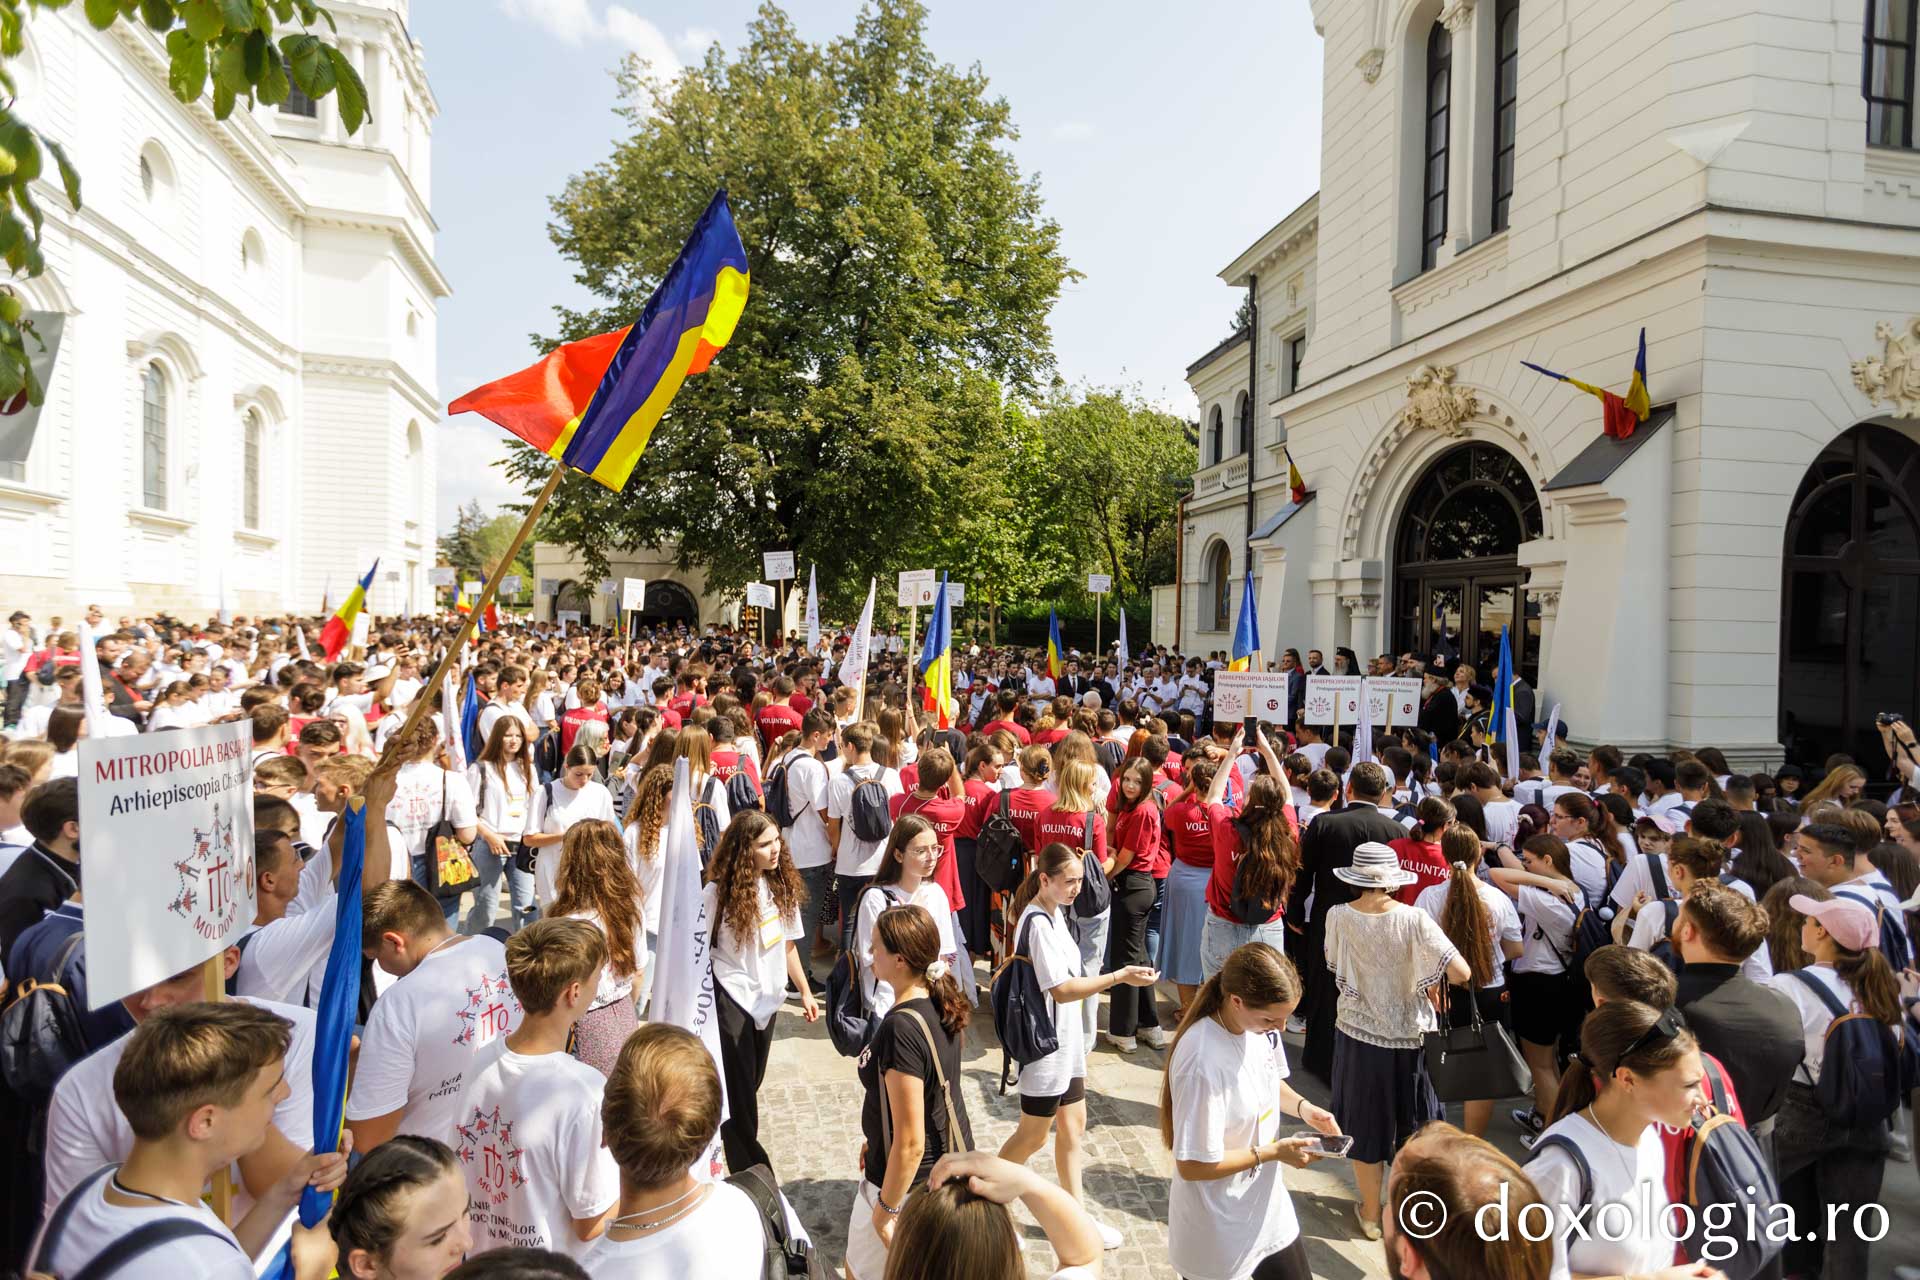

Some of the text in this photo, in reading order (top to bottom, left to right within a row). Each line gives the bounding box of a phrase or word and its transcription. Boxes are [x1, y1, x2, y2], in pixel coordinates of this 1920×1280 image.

[1269, 701, 1278, 709] 15
[1404, 704, 1413, 714] 13
[760, 718, 793, 726] VOLUNTAR
[95, 744, 214, 784] MITROPOLIA
[110, 774, 221, 816] Arhiepiscopia
[1041, 824, 1083, 837] VOLUNTAR
[193, 902, 238, 940] MOLDOVA
